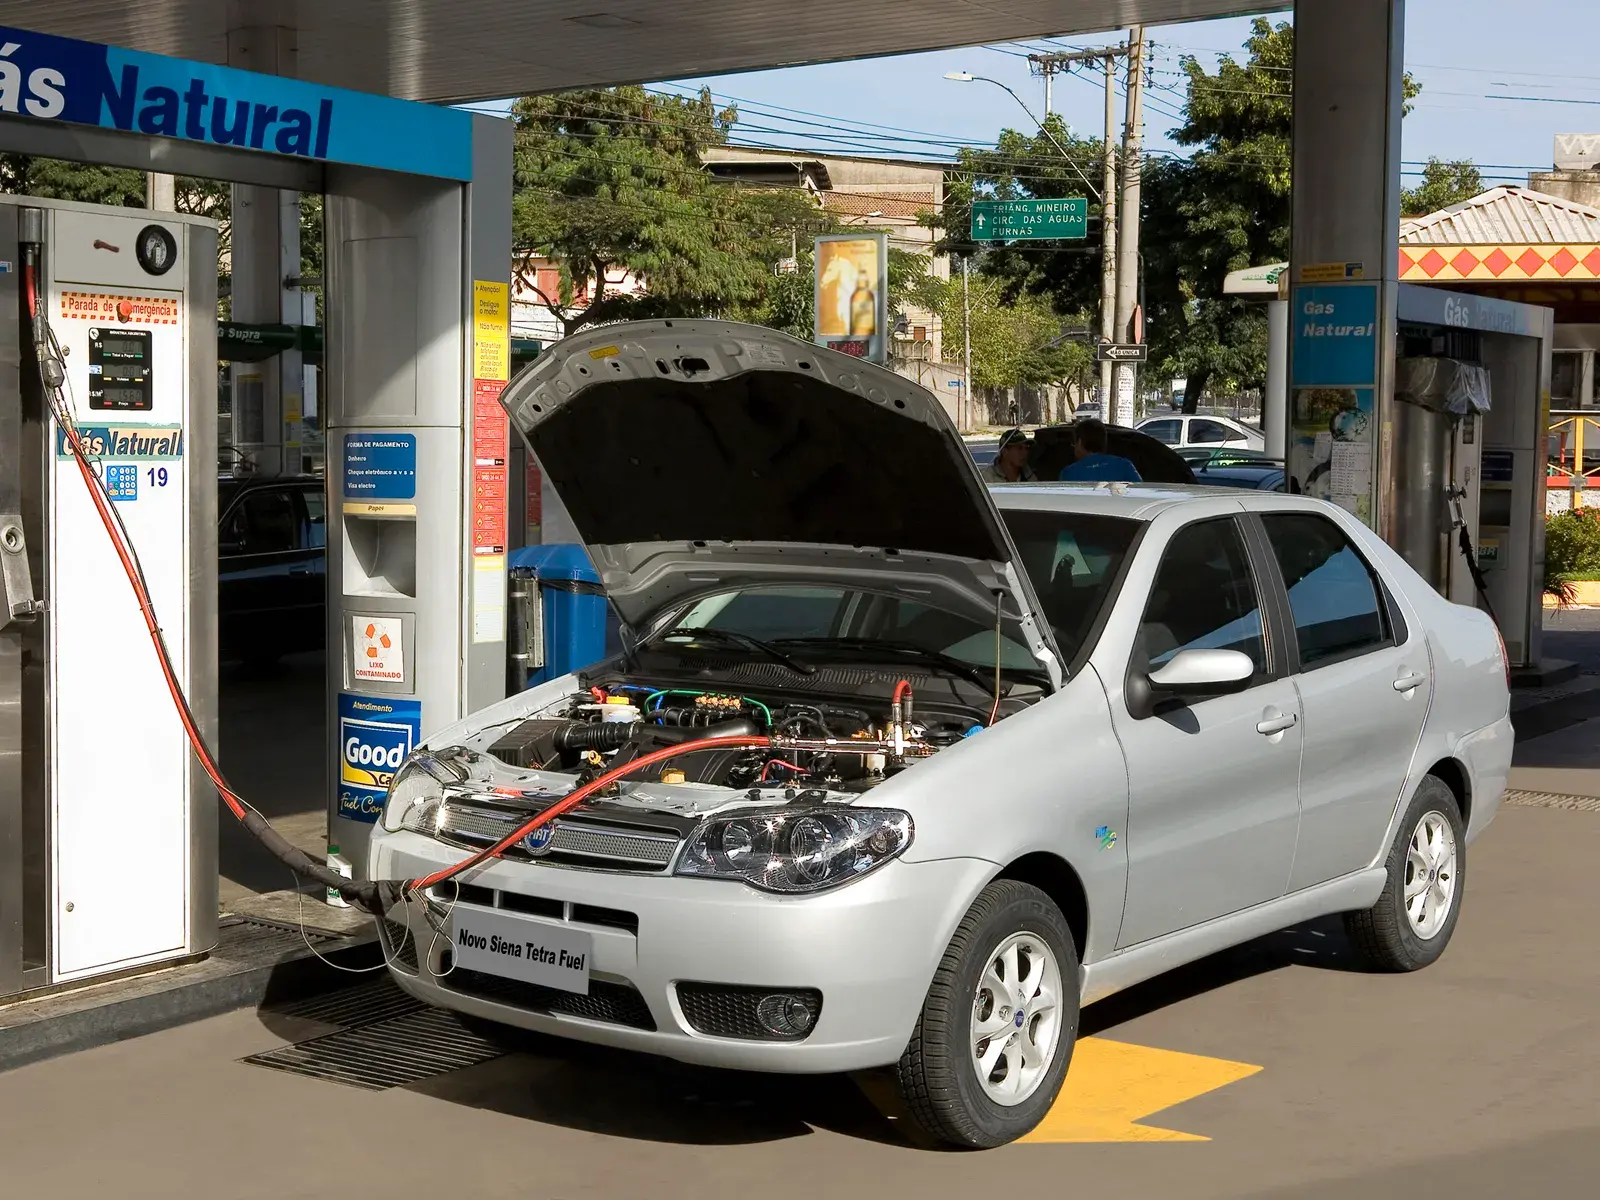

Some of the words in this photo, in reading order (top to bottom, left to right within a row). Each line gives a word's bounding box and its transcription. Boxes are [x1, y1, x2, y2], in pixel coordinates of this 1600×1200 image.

[98, 64, 333, 159] Natural
[1036, 203, 1076, 213] MINEIRO
[1023, 215, 1042, 224] DAS
[992, 227, 1033, 236] FURNAS
[68, 297, 98, 312] Parada
[103, 300, 113, 312] de
[1303, 301, 1335, 315] Gas
[1444, 297, 1469, 328] Gás
[228, 328, 261, 341] Supra
[1303, 322, 1375, 337] Natural
[147, 467, 168, 487] 19
[369, 661, 384, 669] LIXO
[355, 669, 402, 679] CONTAMINADO
[352, 701, 393, 713] Atendimento
[345, 736, 405, 769] Good
[378, 773, 393, 786] Ca
[340, 791, 360, 811] Fuel
[361, 795, 383, 814] Con
[458, 928, 487, 950] Novo
[490, 934, 522, 957] Siena
[525, 942, 556, 965] Tetra
[559, 949, 586, 971] Fuel
